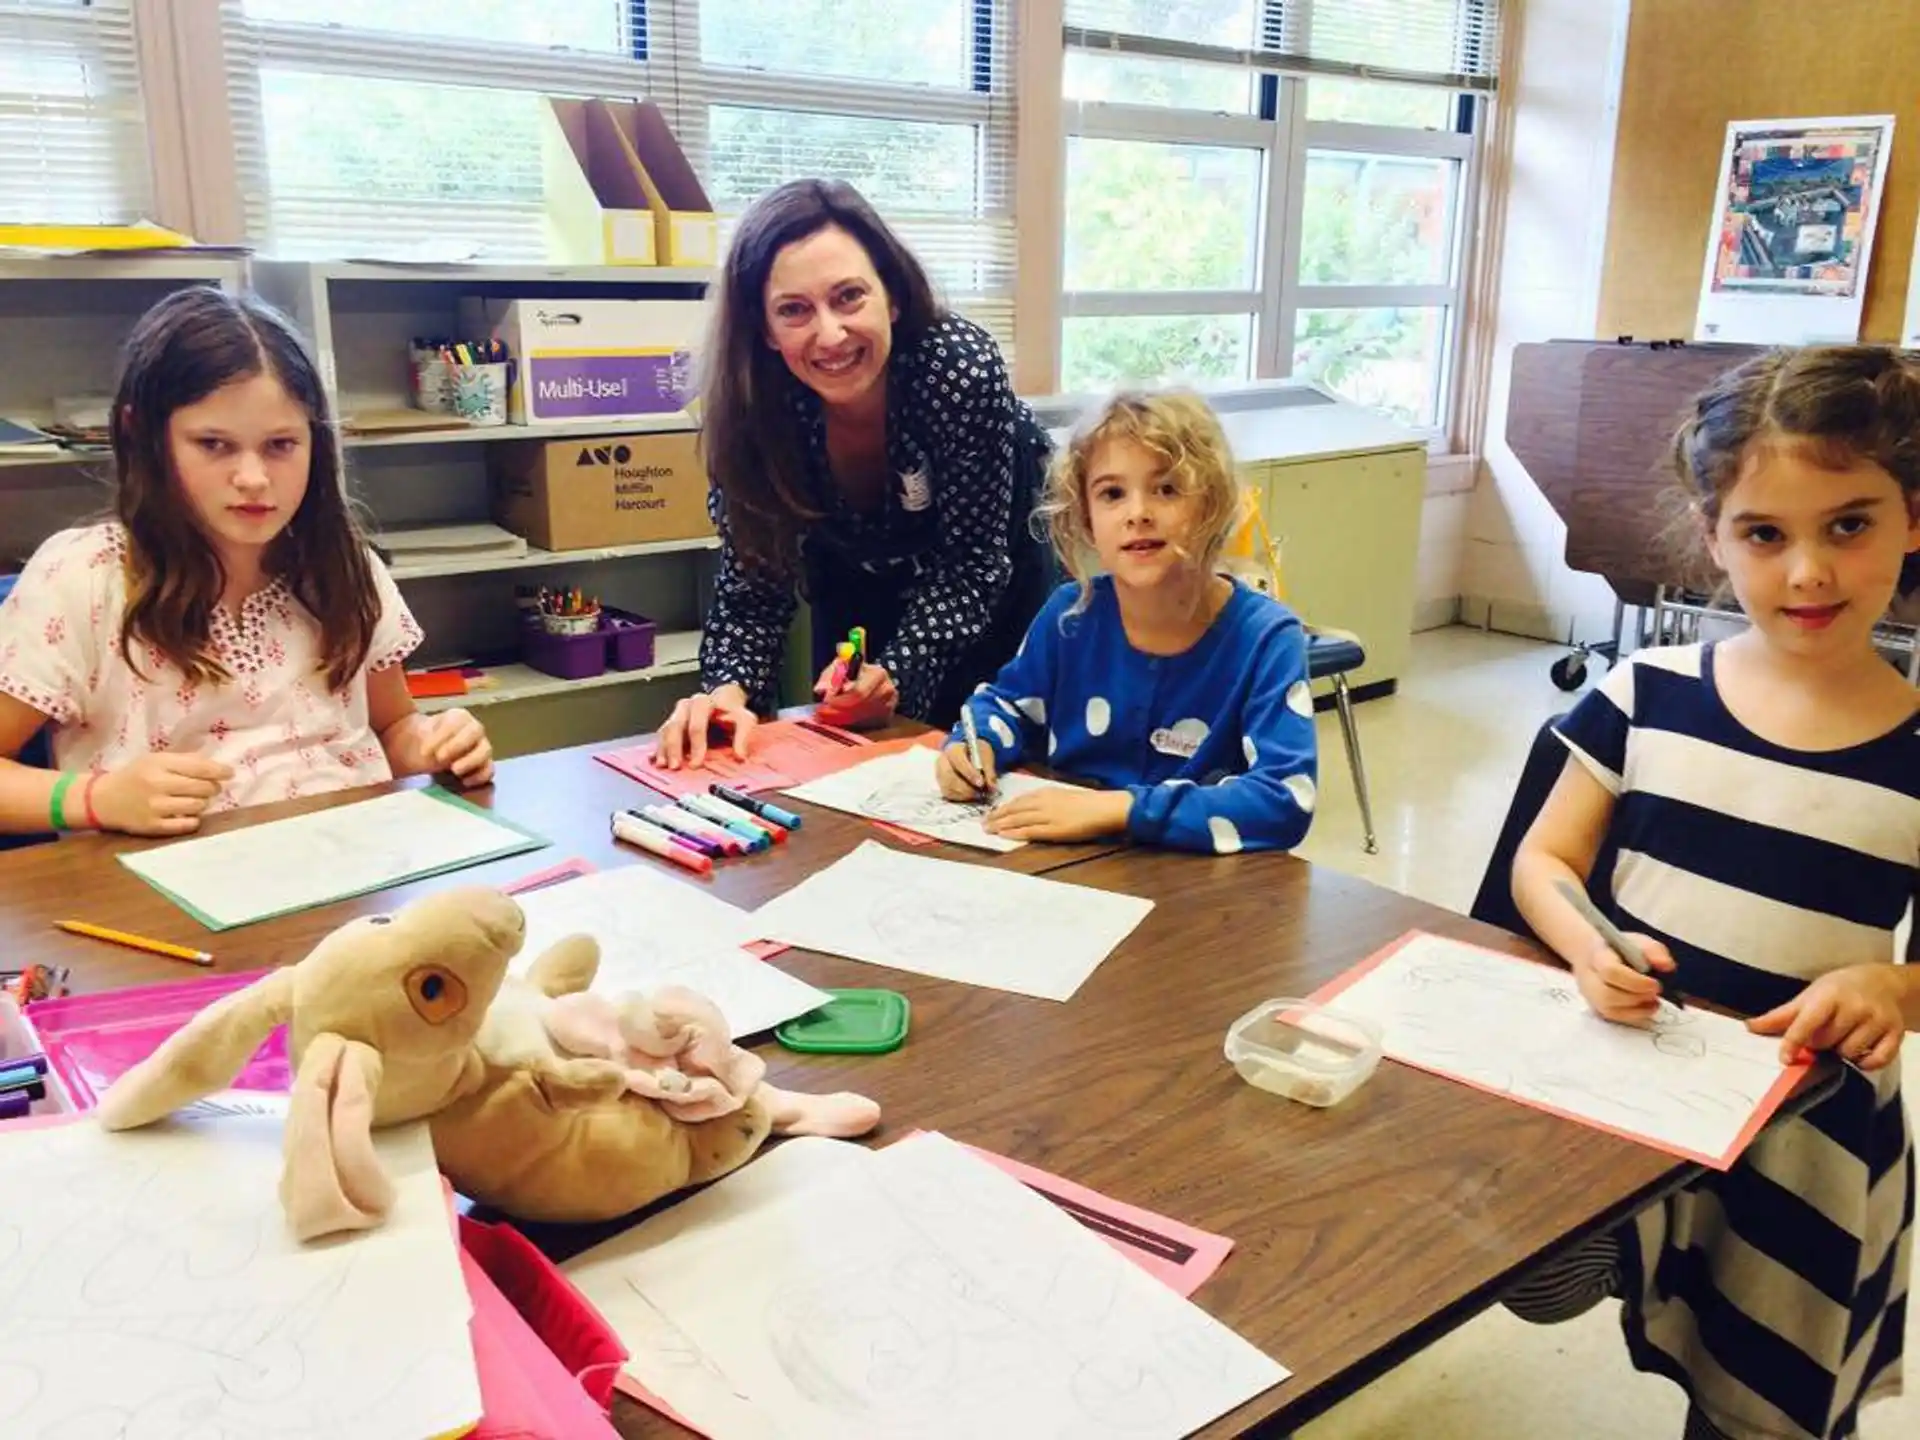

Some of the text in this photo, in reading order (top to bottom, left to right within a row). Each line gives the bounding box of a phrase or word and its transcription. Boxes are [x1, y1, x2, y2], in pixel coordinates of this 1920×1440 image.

[614, 465, 674, 480] Houghton
[615, 483, 654, 494] Mifflin
[615, 498, 666, 511] Harcourt
